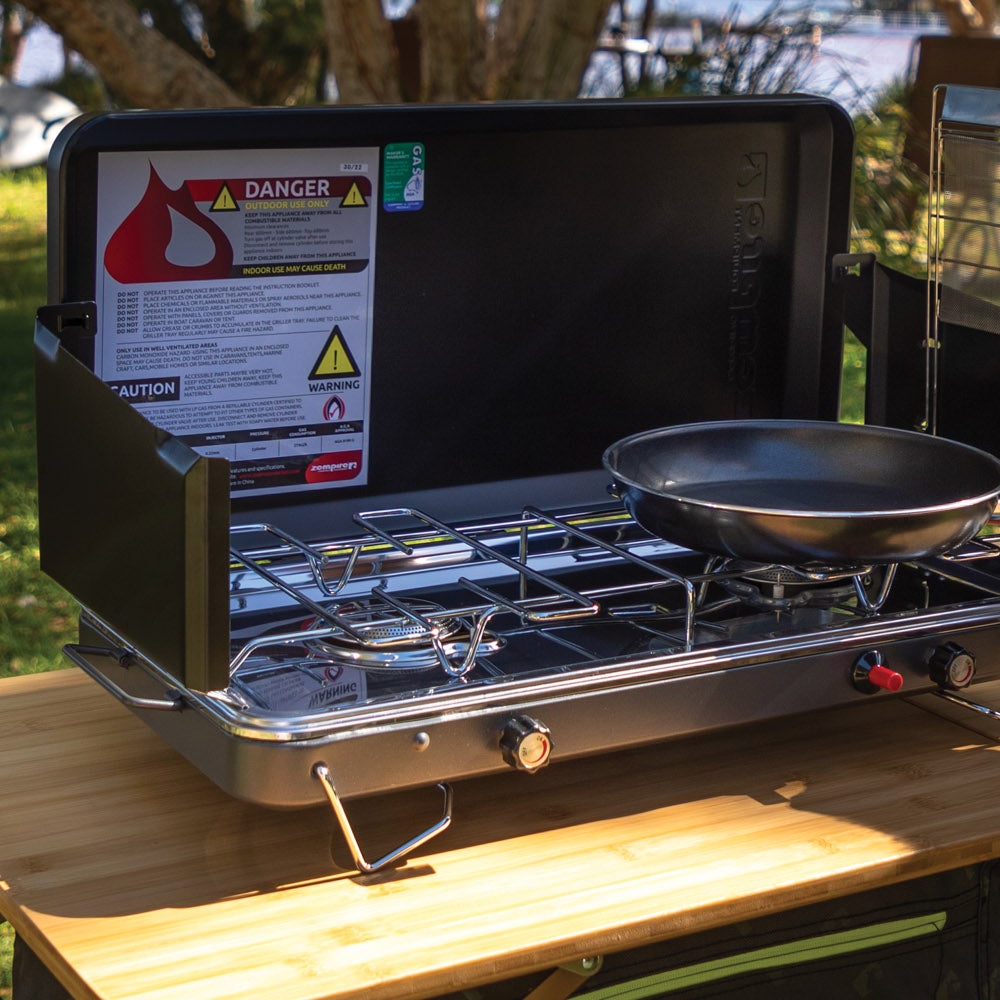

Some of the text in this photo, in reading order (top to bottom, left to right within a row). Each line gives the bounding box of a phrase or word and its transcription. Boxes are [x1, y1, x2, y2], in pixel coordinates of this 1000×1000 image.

[412, 145, 422, 176] GAS
[246, 180, 330, 198] DANGER
[111, 382, 175, 397] AUTION
[309, 380, 360, 392] WARNING
